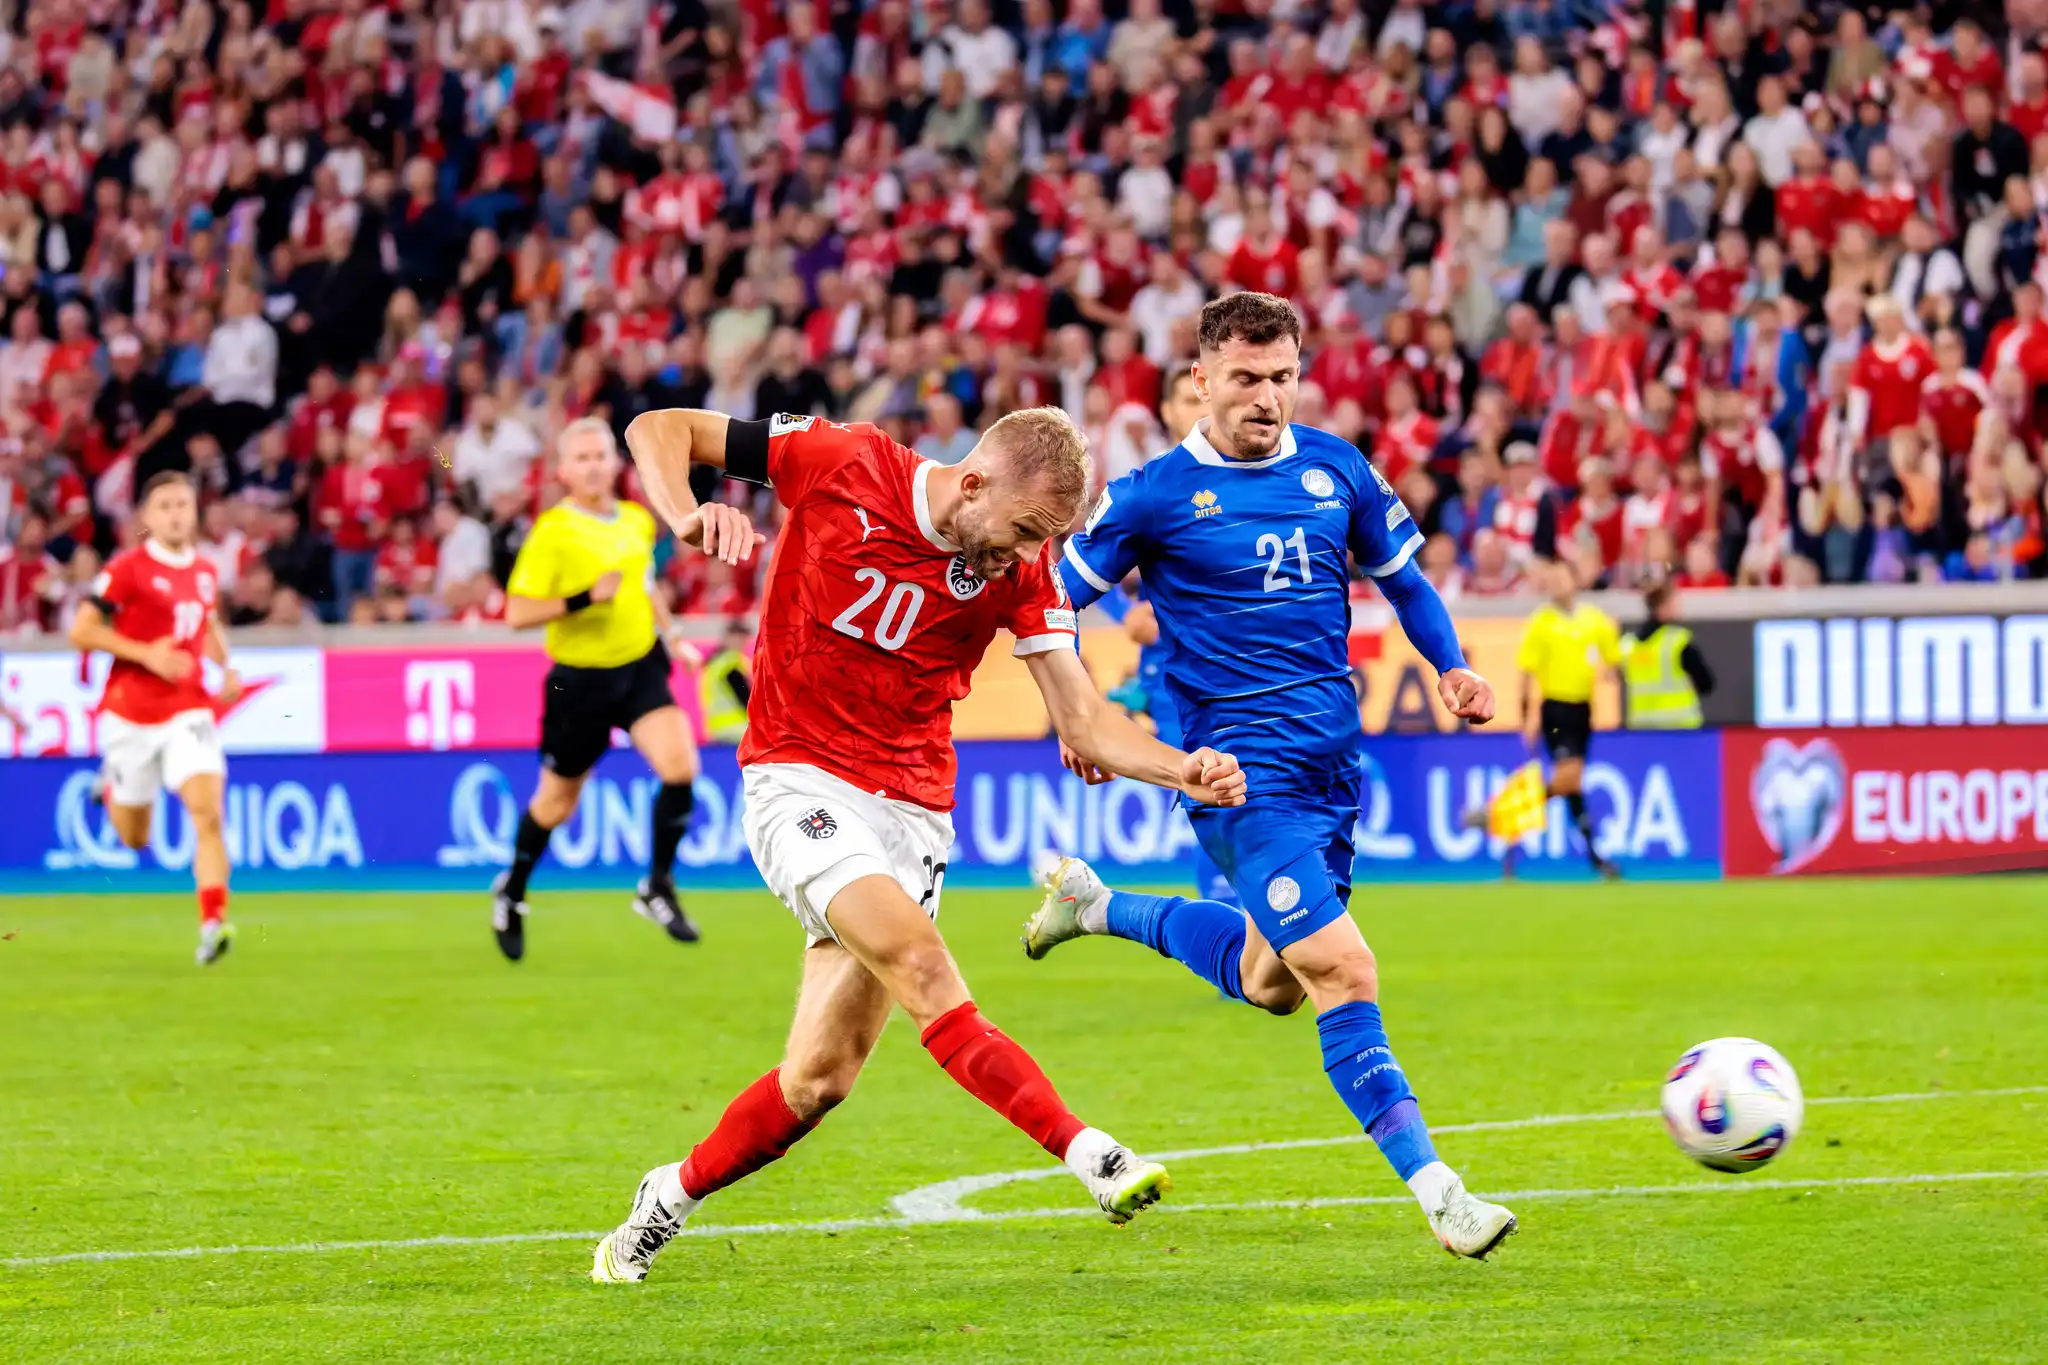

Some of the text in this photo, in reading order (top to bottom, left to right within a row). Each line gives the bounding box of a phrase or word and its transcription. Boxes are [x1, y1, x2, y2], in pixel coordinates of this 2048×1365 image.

[1314, 500, 1340, 509] CYPRUS
[1256, 526, 1313, 593] 21
[832, 567, 925, 651] 20
[1280, 907, 1309, 926] CYPRUS
